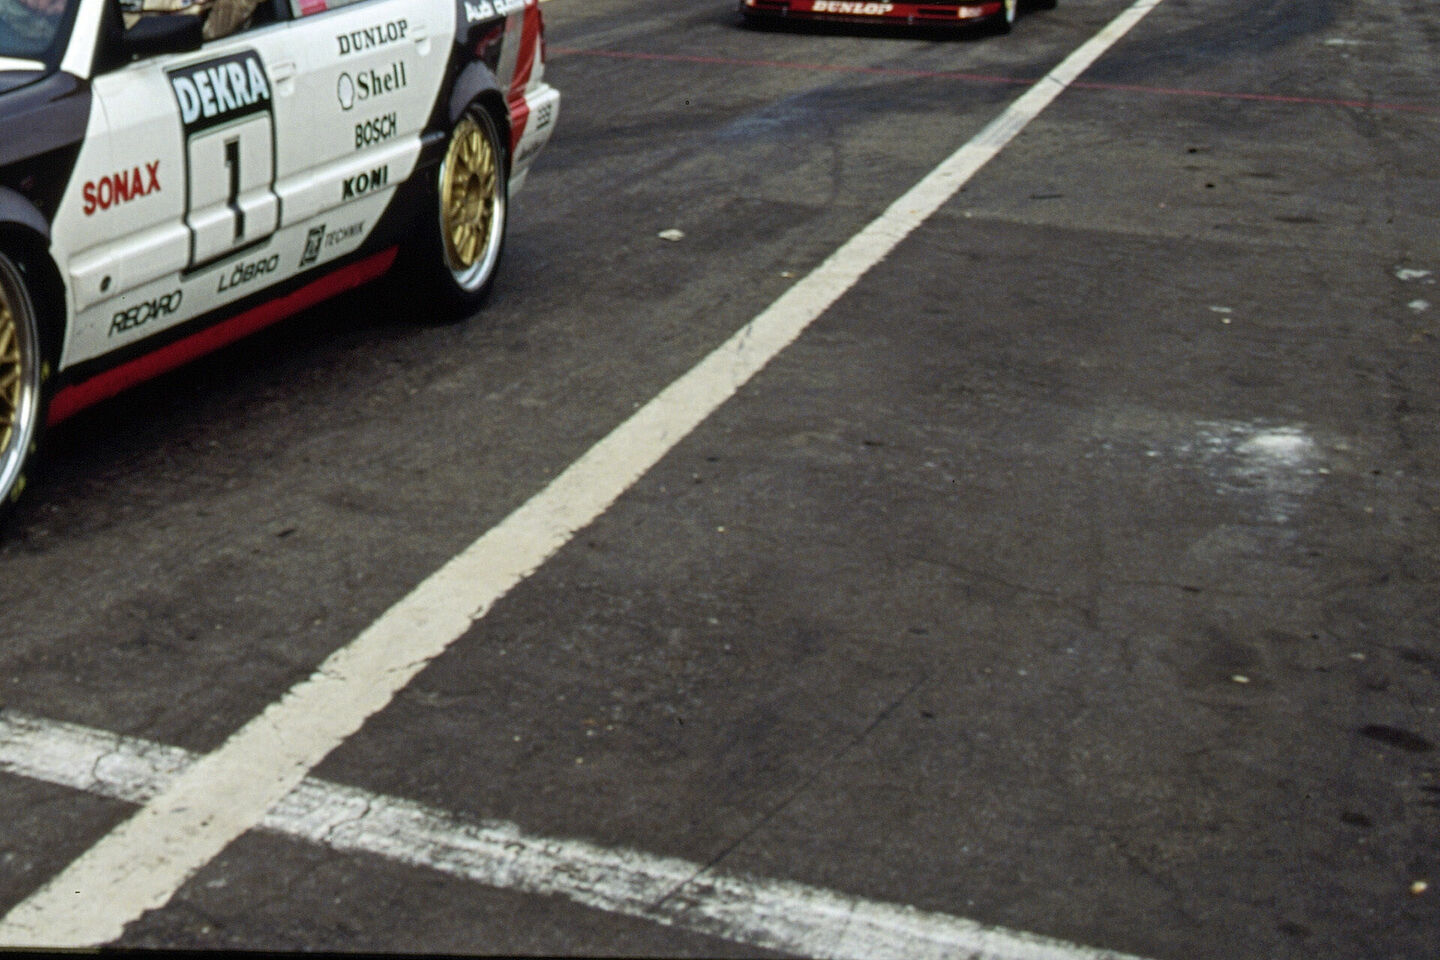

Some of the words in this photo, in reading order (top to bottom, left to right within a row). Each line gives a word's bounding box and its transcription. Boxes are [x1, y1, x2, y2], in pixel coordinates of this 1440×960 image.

[812, 0, 894, 16] DUNLOP
[337, 19, 408, 56] DUNLOP
[172, 52, 270, 125] DEKRA
[357, 62, 407, 101] Shell
[355, 112, 397, 149] BOSCH
[83, 160, 162, 217] SONAX
[224, 134, 247, 244] 1
[342, 165, 389, 201] KONI
[217, 254, 280, 294] LÖBRO
[108, 289, 183, 338] RECARO
